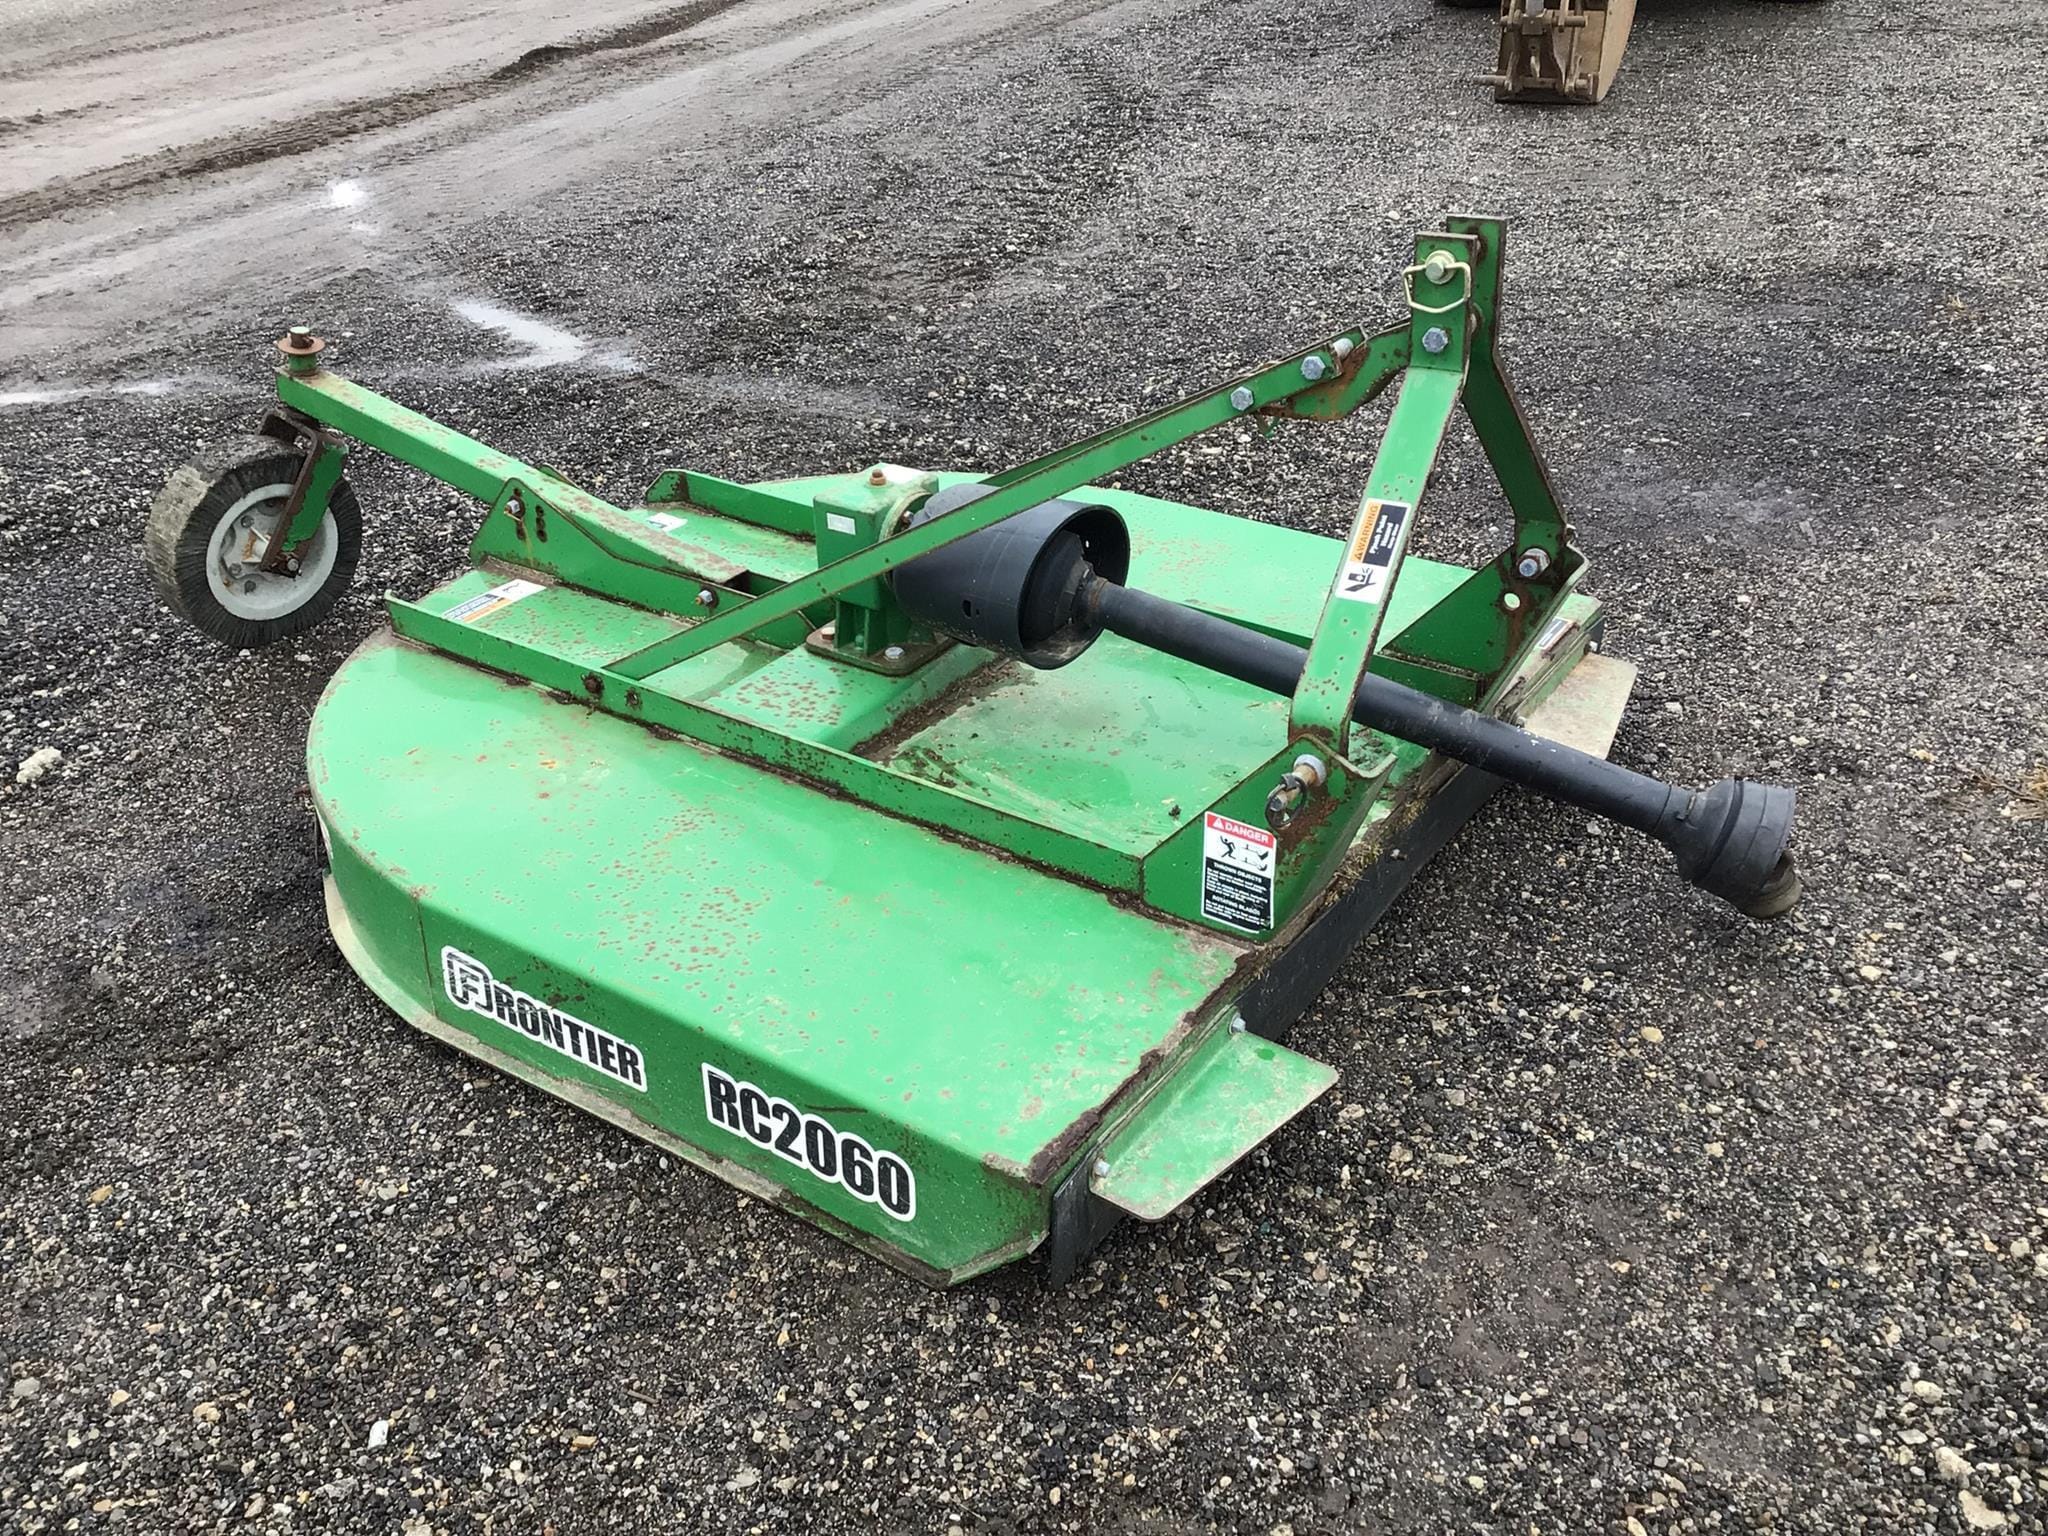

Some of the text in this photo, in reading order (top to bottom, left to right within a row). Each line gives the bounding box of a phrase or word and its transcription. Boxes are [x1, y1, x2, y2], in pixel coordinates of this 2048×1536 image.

[1357, 505, 1379, 553] WARNING
[1225, 821, 1269, 843] DANGER
[447, 951, 642, 1086] FRONTIER
[708, 1070, 910, 1216] RC2060
